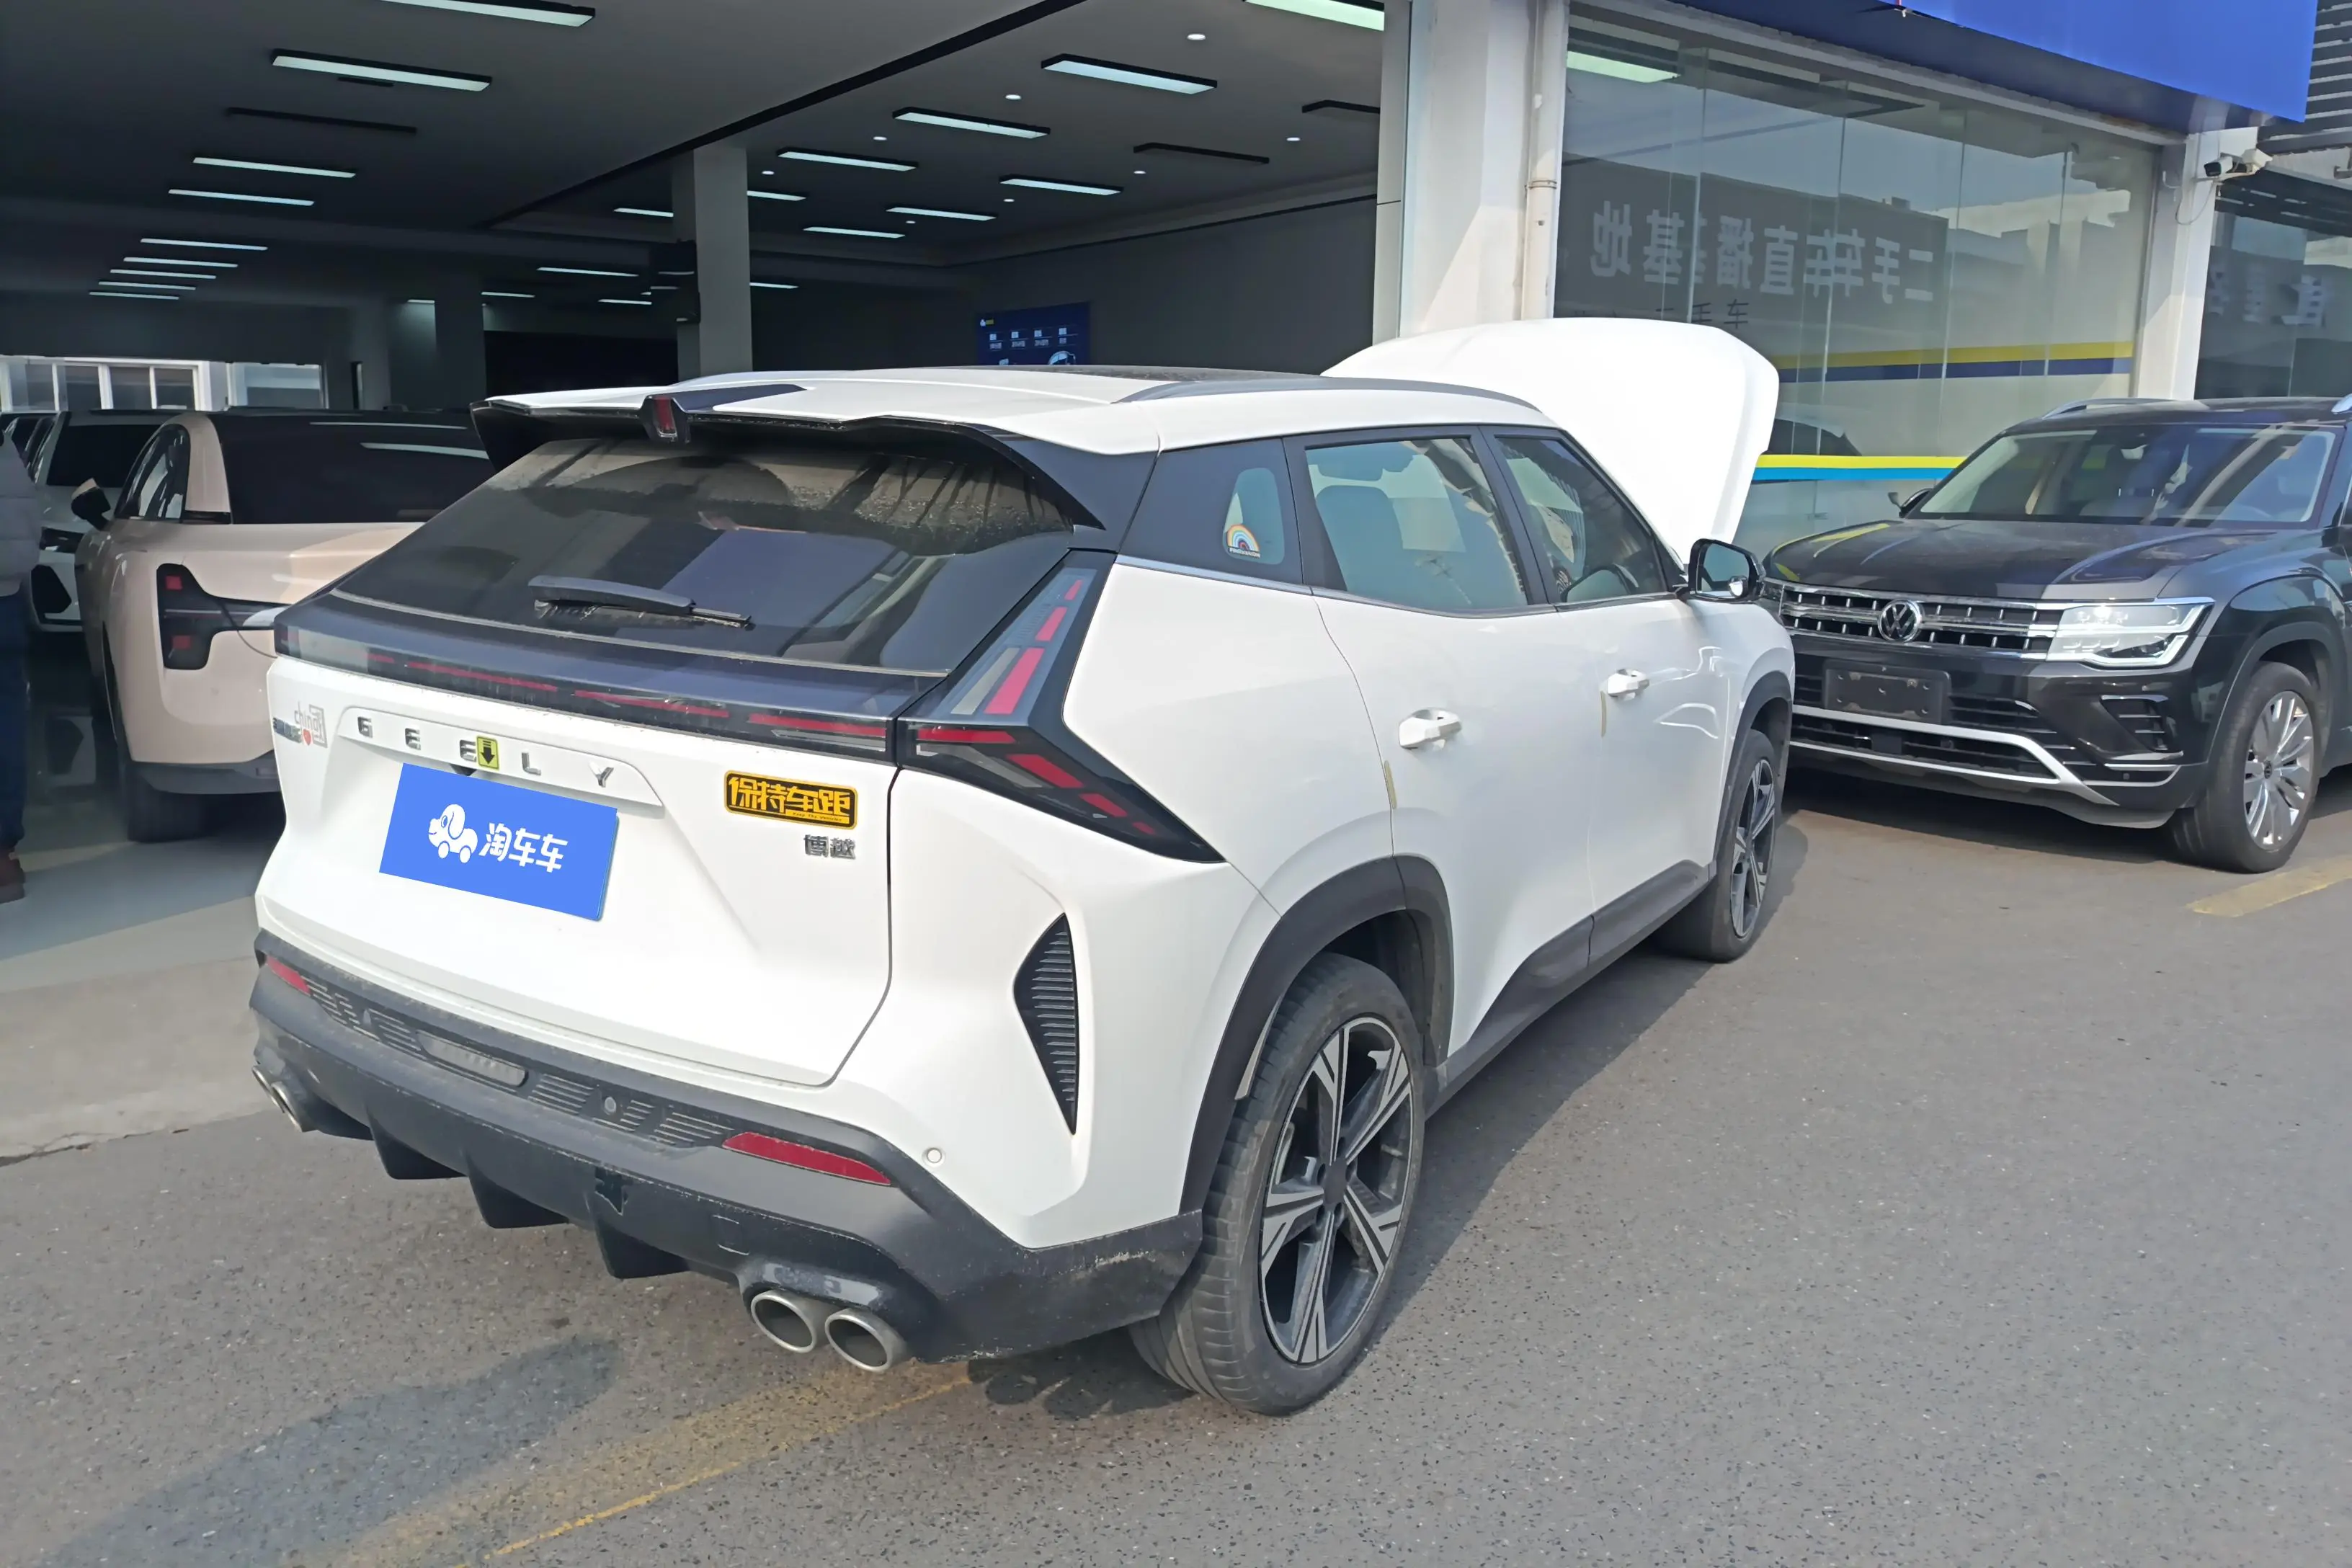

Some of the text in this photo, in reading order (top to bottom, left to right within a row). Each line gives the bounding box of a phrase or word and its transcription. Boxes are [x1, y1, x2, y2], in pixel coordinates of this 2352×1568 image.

[357, 716, 614, 788] GEELY
[729, 777, 850, 816] 保持车距
